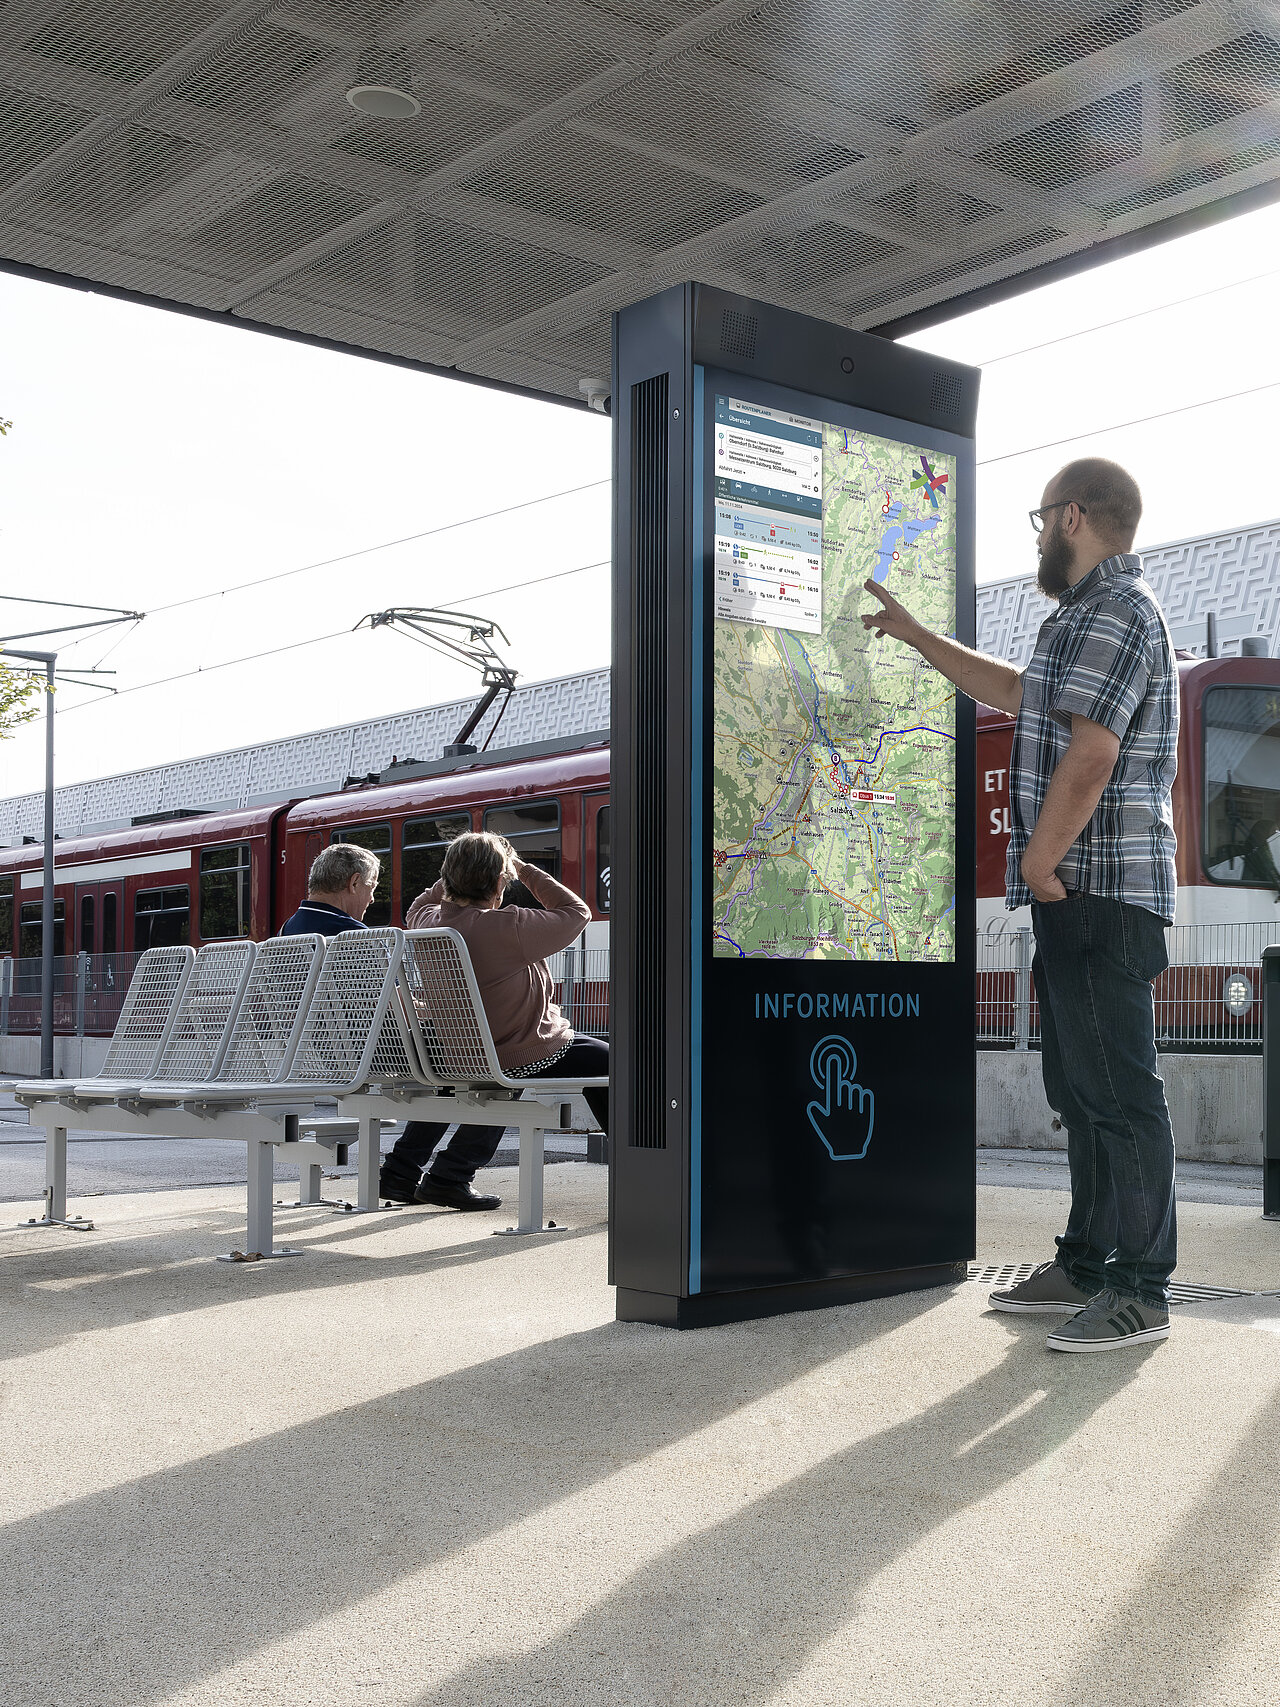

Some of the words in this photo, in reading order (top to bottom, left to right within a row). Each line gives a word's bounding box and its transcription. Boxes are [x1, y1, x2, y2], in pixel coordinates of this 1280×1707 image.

[794, 418, 812, 427] MONITOR
[984, 769, 1007, 792] ET
[830, 806, 853, 818] Salzburg
[281, 850, 287, 864] 5
[755, 993, 920, 1019] INFORMATION
